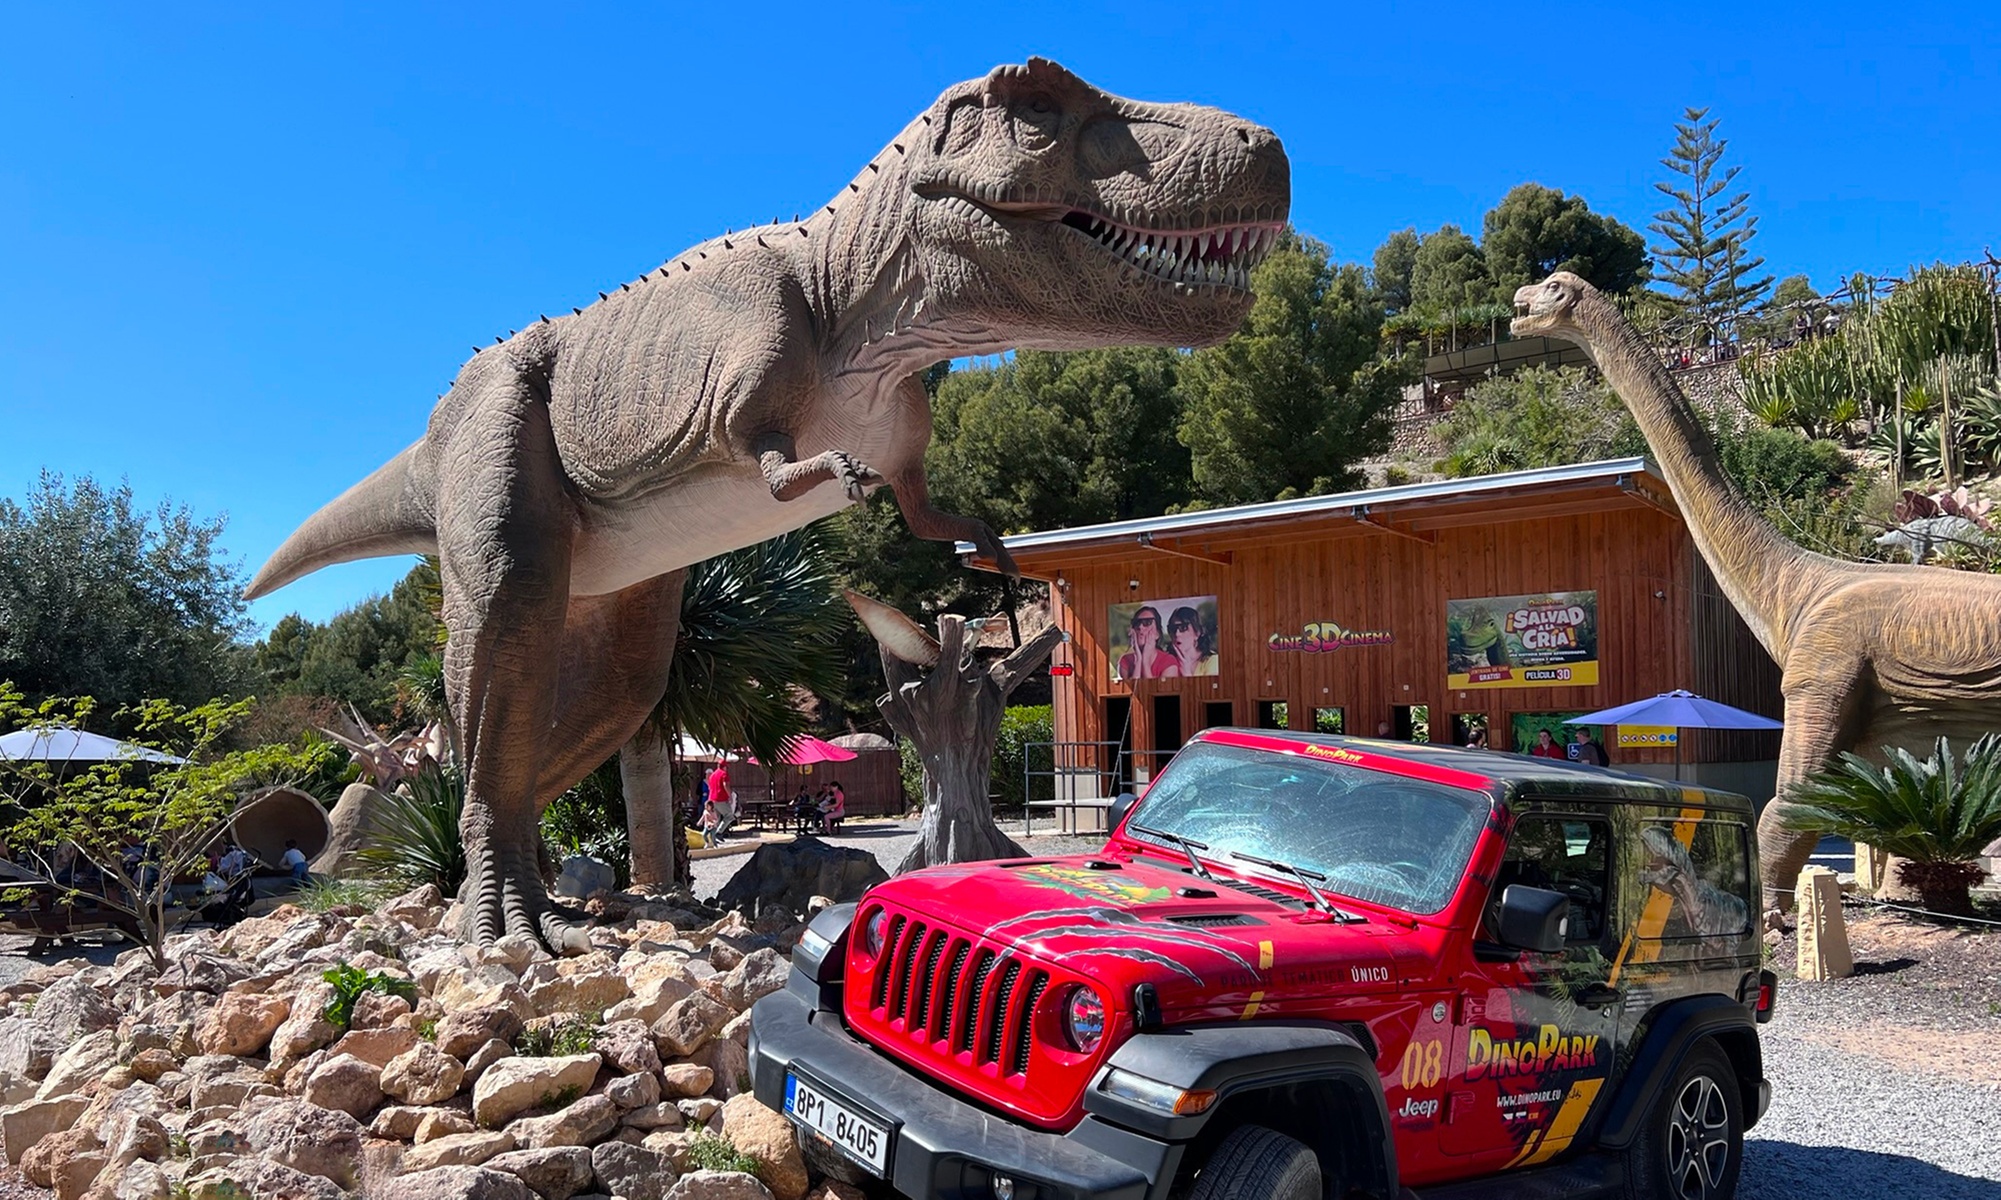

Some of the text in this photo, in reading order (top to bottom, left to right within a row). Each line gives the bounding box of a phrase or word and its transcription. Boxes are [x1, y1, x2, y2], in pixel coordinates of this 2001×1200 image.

[1505, 606, 1585, 632] ¡SALVAD
[1268, 622, 1393, 652] CINE 3D CINEMA
[1522, 627, 1577, 649] CRÍA!
[1525, 668, 1571, 680] PELÍCULA 3D
[1304, 744, 1364, 763] DINOPARK
[1351, 965, 1389, 983] ÚNICO
[1465, 1023, 1599, 1082] DINOPARK
[1401, 1039, 1442, 1090] 08
[785, 1096, 794, 1108] CZ
[1399, 1097, 1439, 1118] Jeep
[1496, 1089, 1562, 1108] WWW.DINOPARK.EU
[796, 1087, 879, 1159] 8P1 8405
